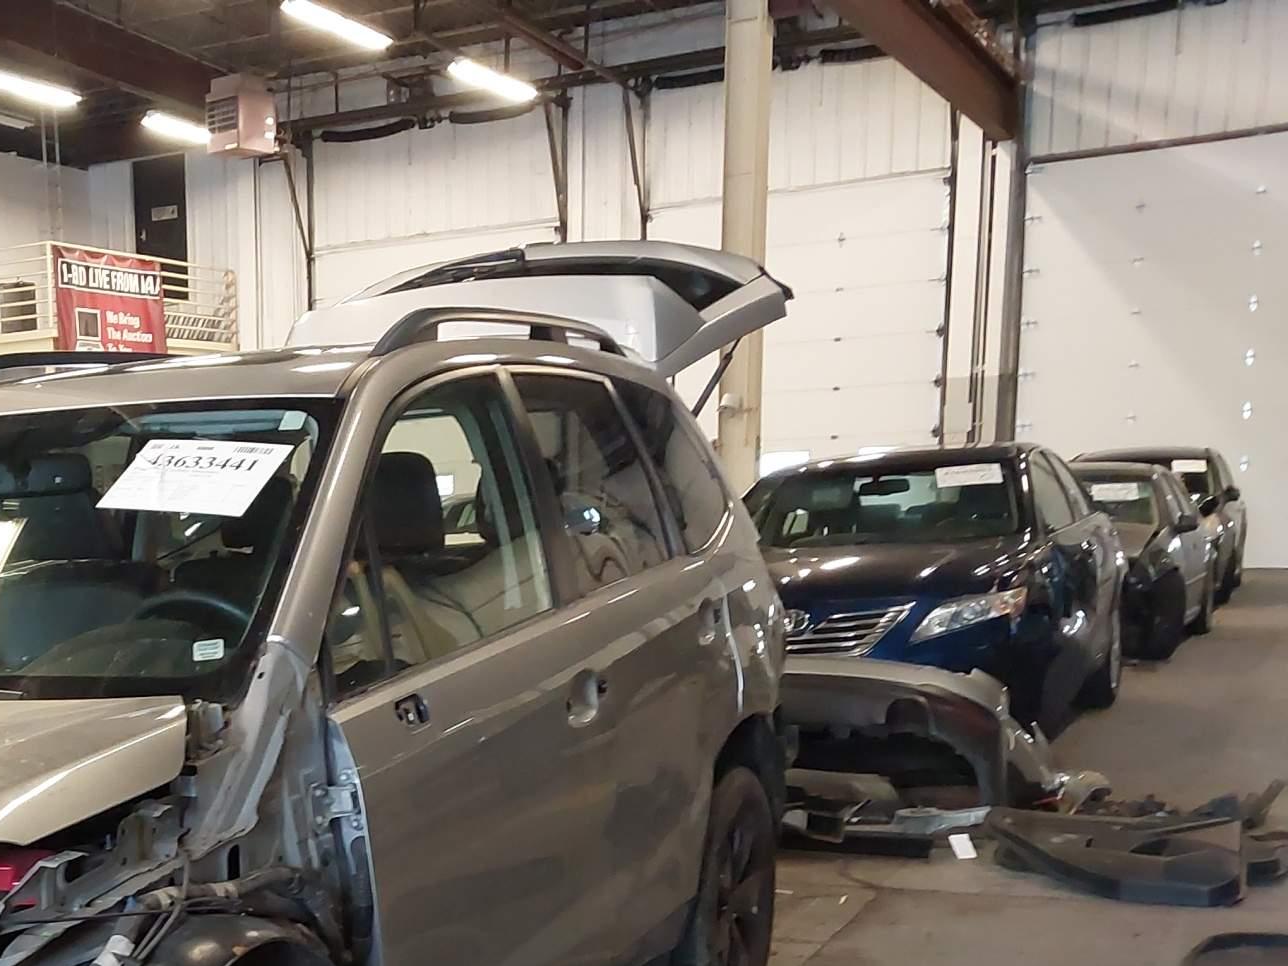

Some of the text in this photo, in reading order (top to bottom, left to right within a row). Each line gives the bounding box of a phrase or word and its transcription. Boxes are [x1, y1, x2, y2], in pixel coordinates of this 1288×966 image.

[88, 267, 110, 289] LIVE
[110, 270, 139, 293] FROM
[107, 327, 121, 340] The
[147, 453, 260, 472] 43633441
